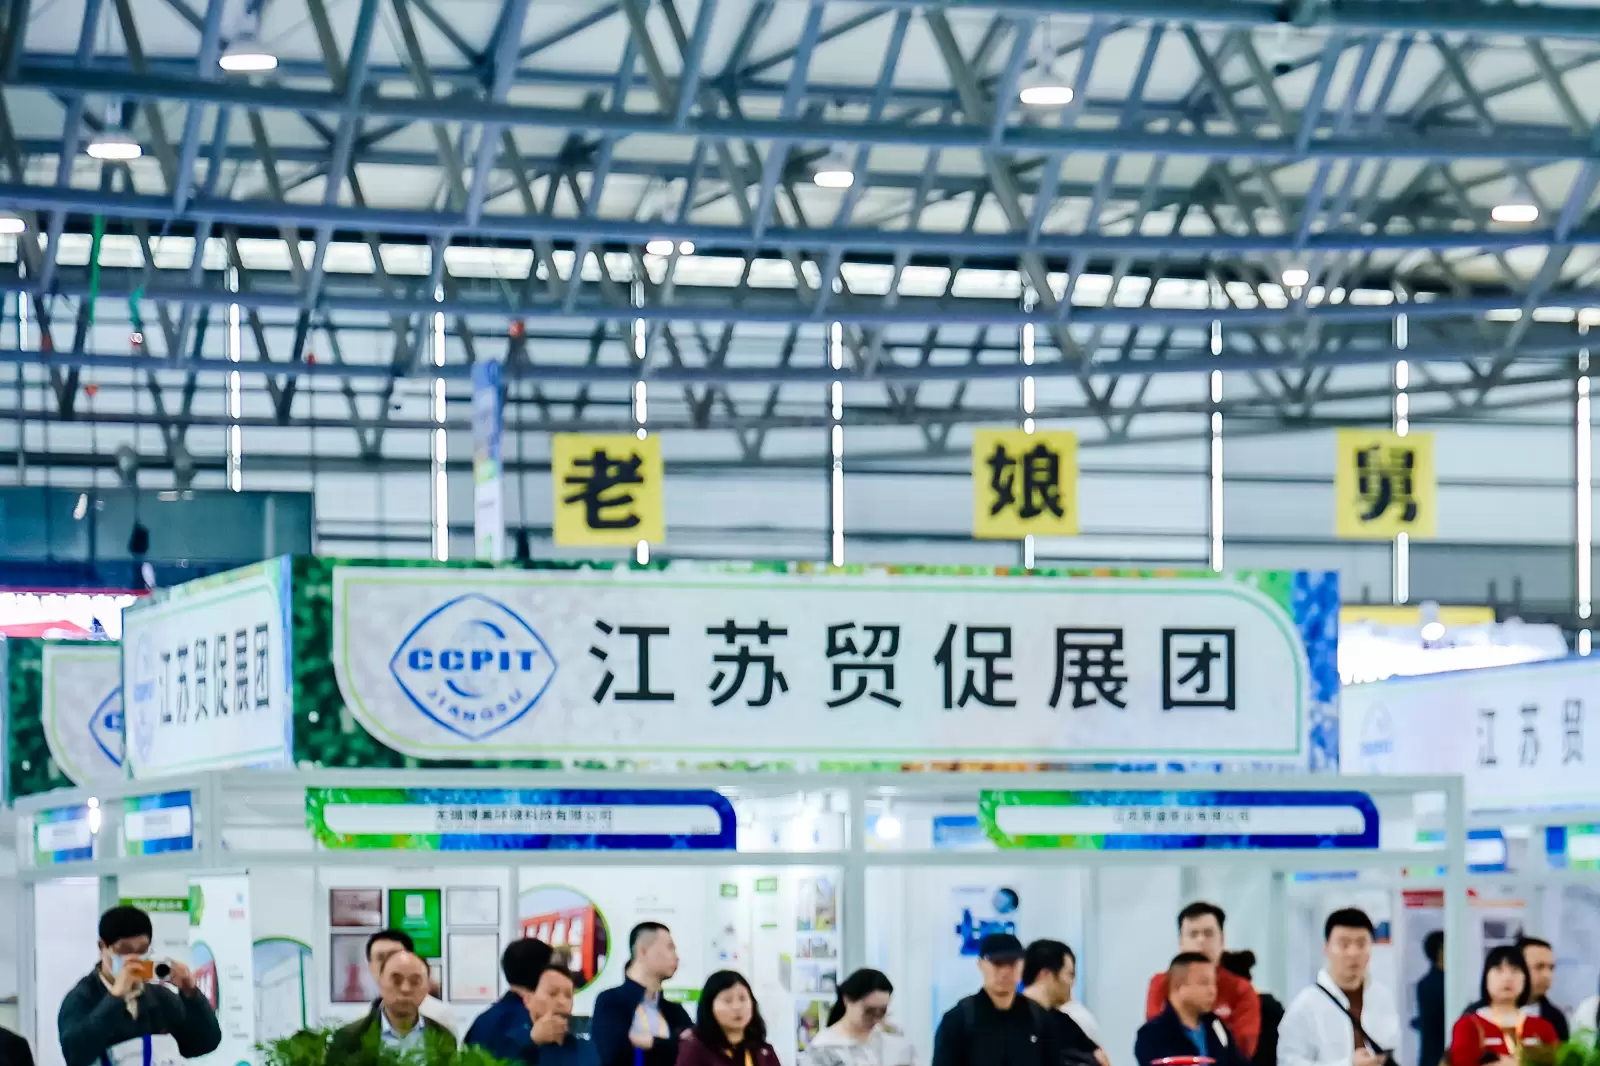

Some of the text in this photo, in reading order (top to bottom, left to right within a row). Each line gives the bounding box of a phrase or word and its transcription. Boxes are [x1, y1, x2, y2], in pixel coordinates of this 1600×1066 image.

[565, 451, 645, 531] 老
[986, 443, 1066, 520] 娘
[1356, 447, 1419, 524] 舅
[159, 623, 270, 724] 江苏贸促展团
[407, 648, 539, 672] CCPIT
[590, 618, 1237, 712] 江苏贸促展团
